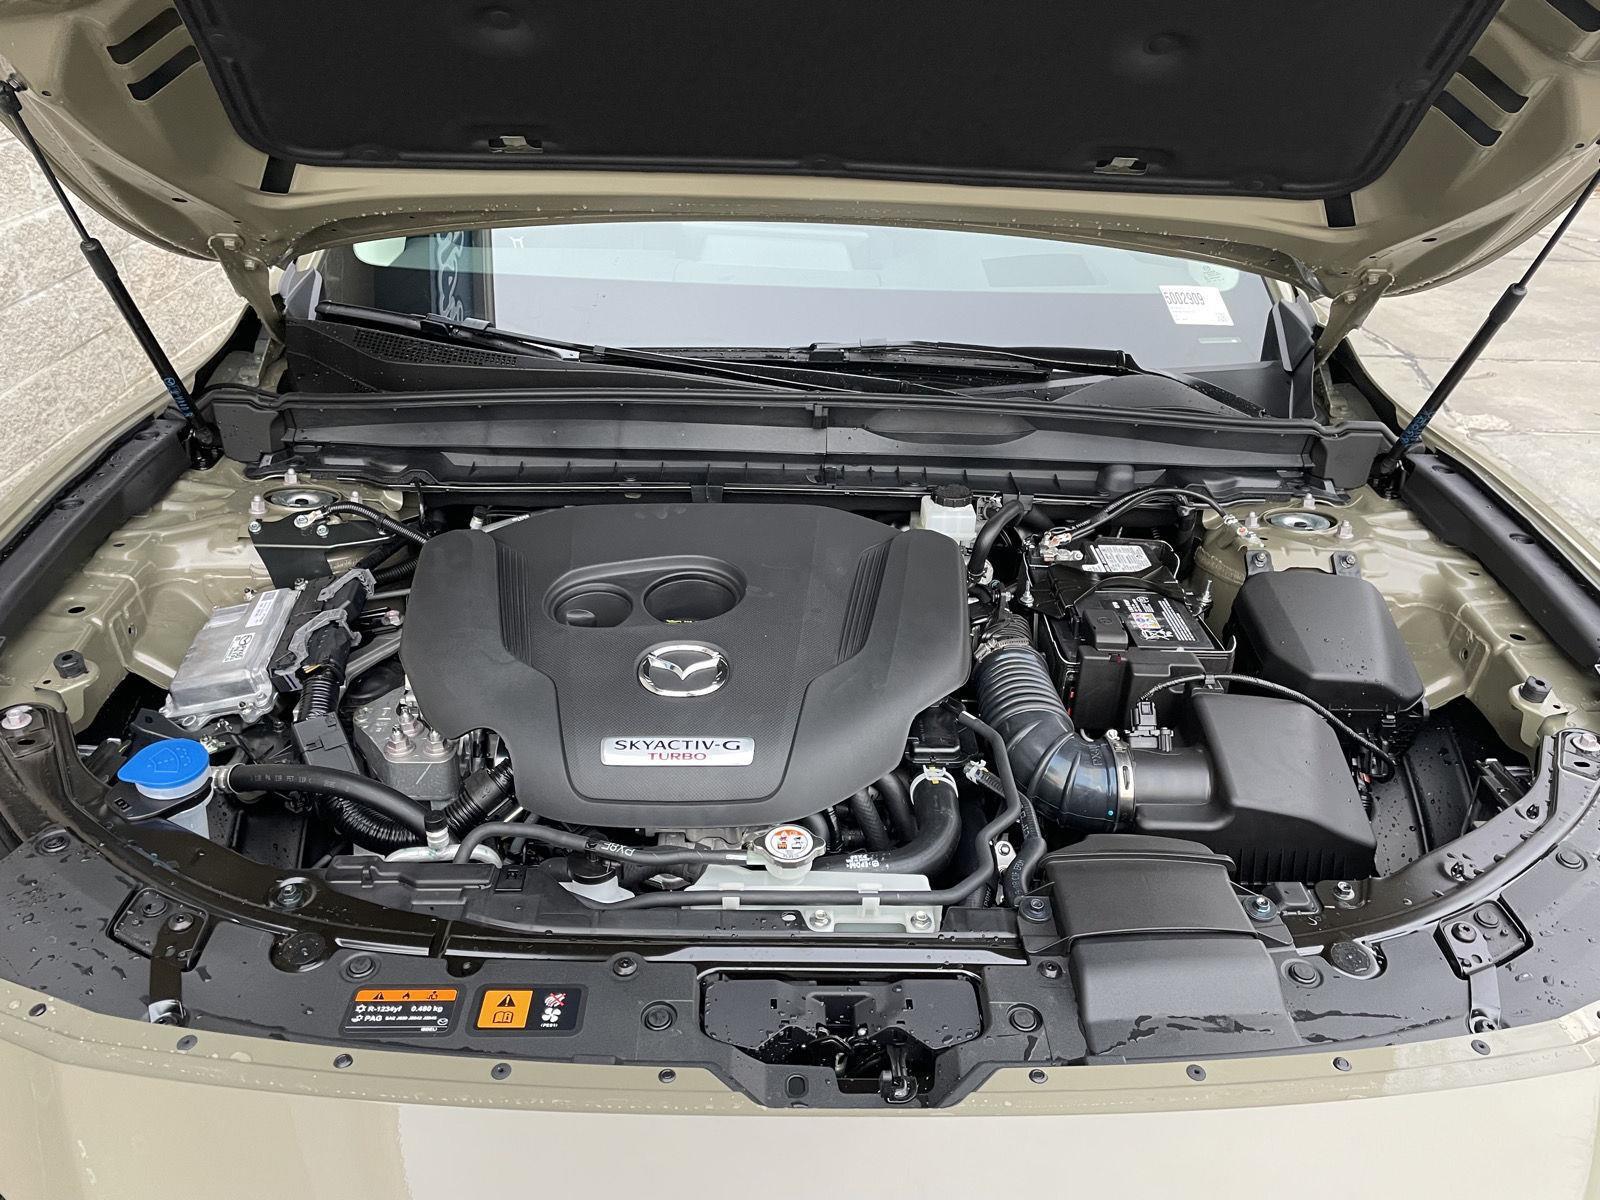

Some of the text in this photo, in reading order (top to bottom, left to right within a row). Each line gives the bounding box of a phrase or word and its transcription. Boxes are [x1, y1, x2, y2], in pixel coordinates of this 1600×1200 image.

[1164, 292, 1205, 305] 5002909
[614, 740, 741, 751] SKYACTIV-G
[648, 752, 707, 761] TURBO
[433, 1005, 444, 1013] kg
